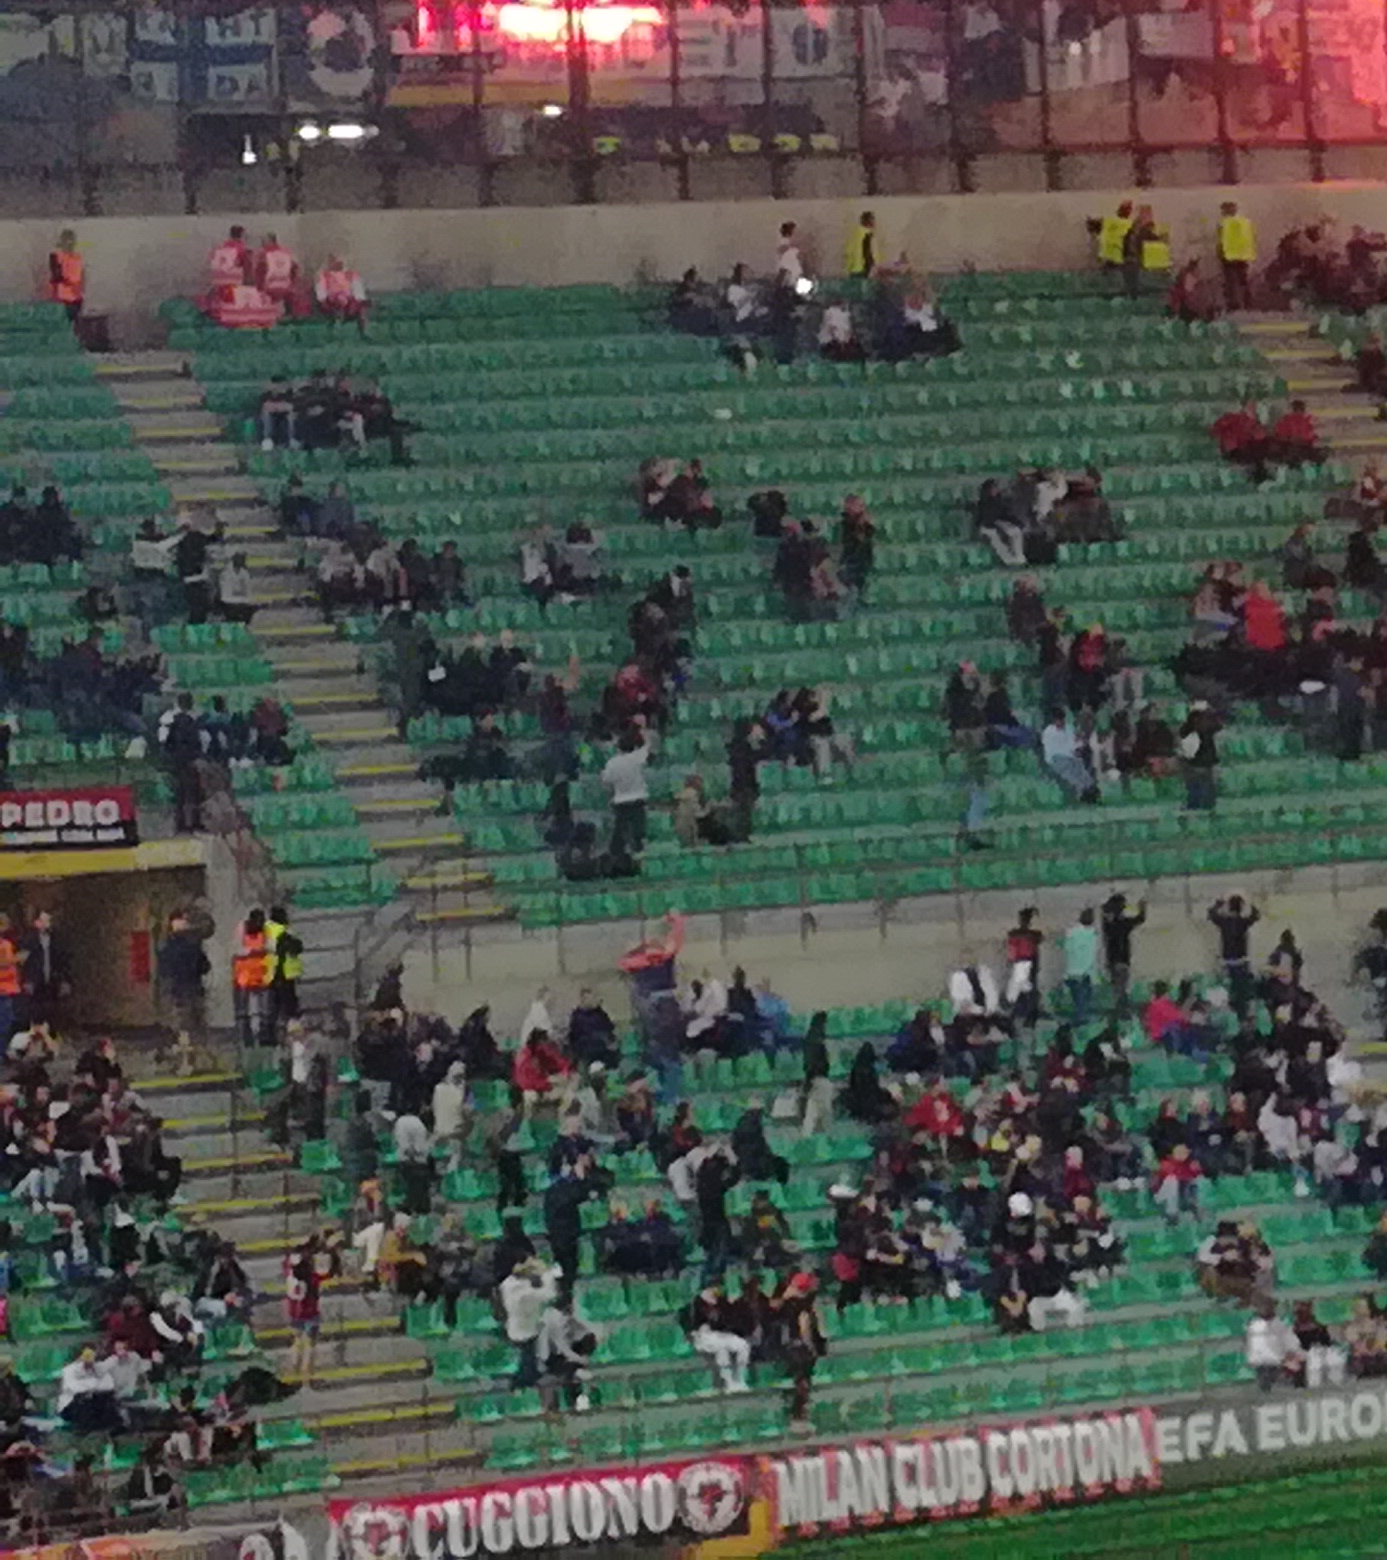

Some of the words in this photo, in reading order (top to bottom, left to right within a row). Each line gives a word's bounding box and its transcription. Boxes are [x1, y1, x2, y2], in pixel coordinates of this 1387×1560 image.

[775, 1446, 890, 1526] MILAN
[892, 1436, 990, 1511] CLUB
[989, 1414, 1150, 1495] CORTONA
[1155, 1407, 1249, 1463] EFA
